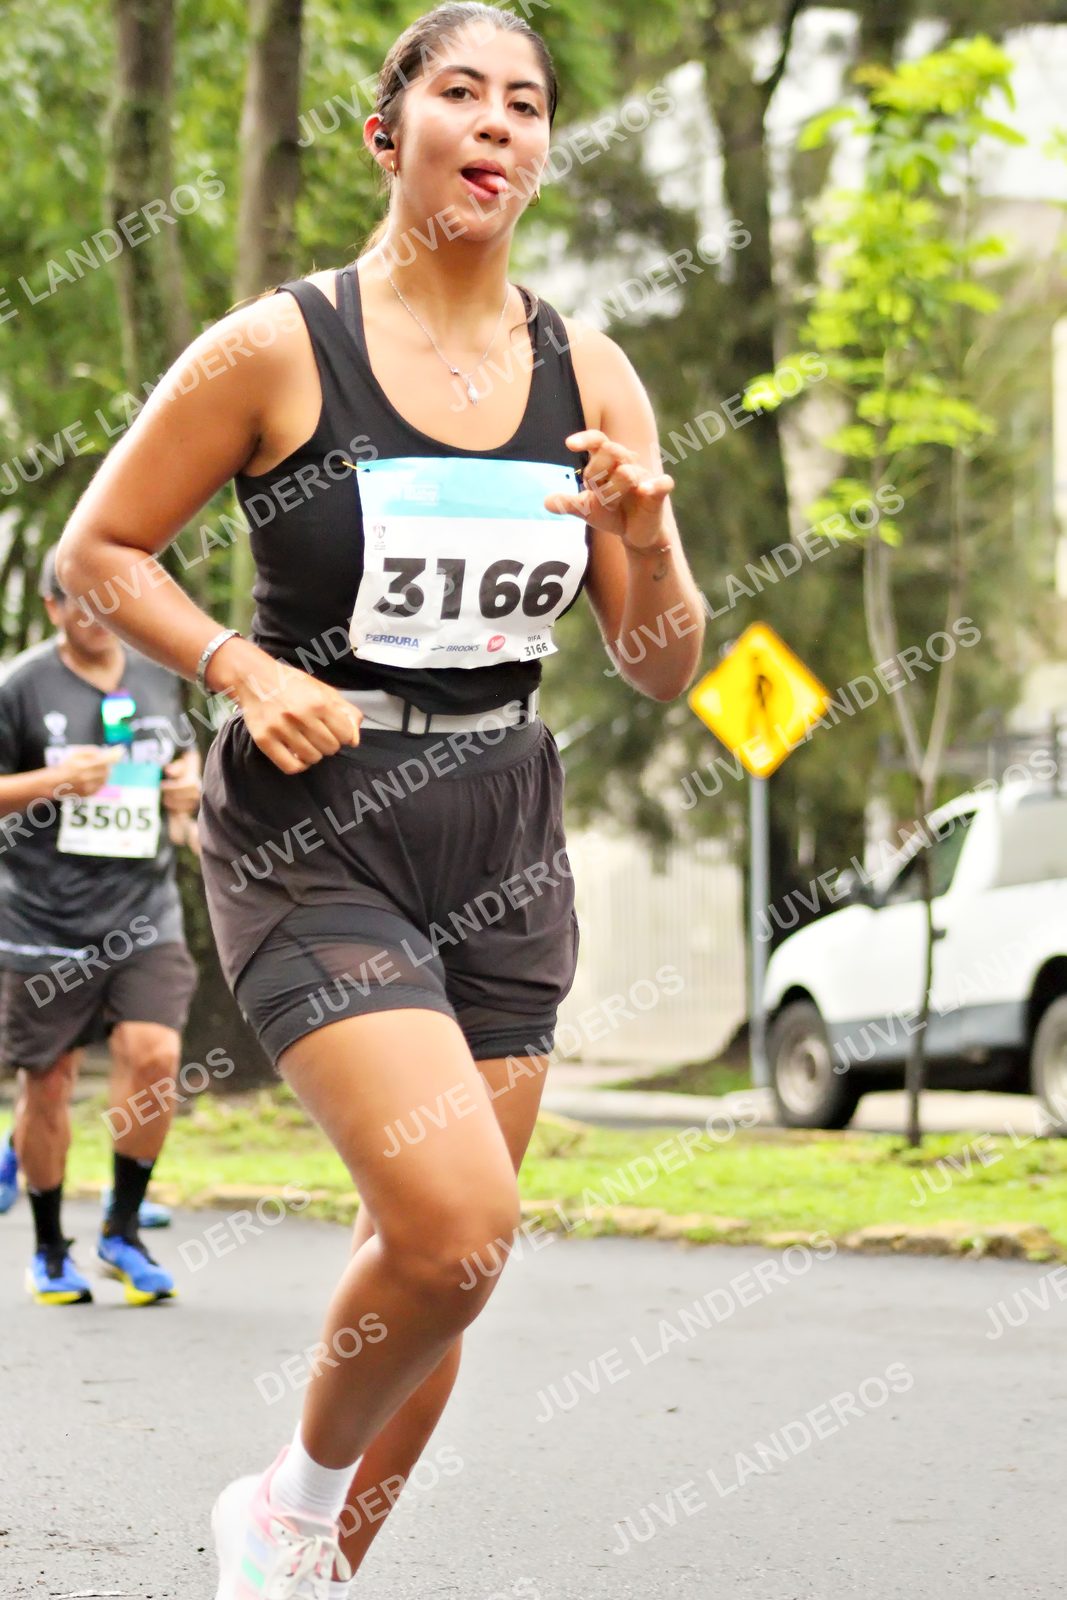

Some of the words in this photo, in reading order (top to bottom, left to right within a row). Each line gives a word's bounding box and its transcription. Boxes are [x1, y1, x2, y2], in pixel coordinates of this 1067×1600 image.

[372, 557, 571, 620] 3166
[365, 633, 420, 648] PERDURA
[446, 644, 480, 652] BROOKS
[524, 642, 549, 657] 3166
